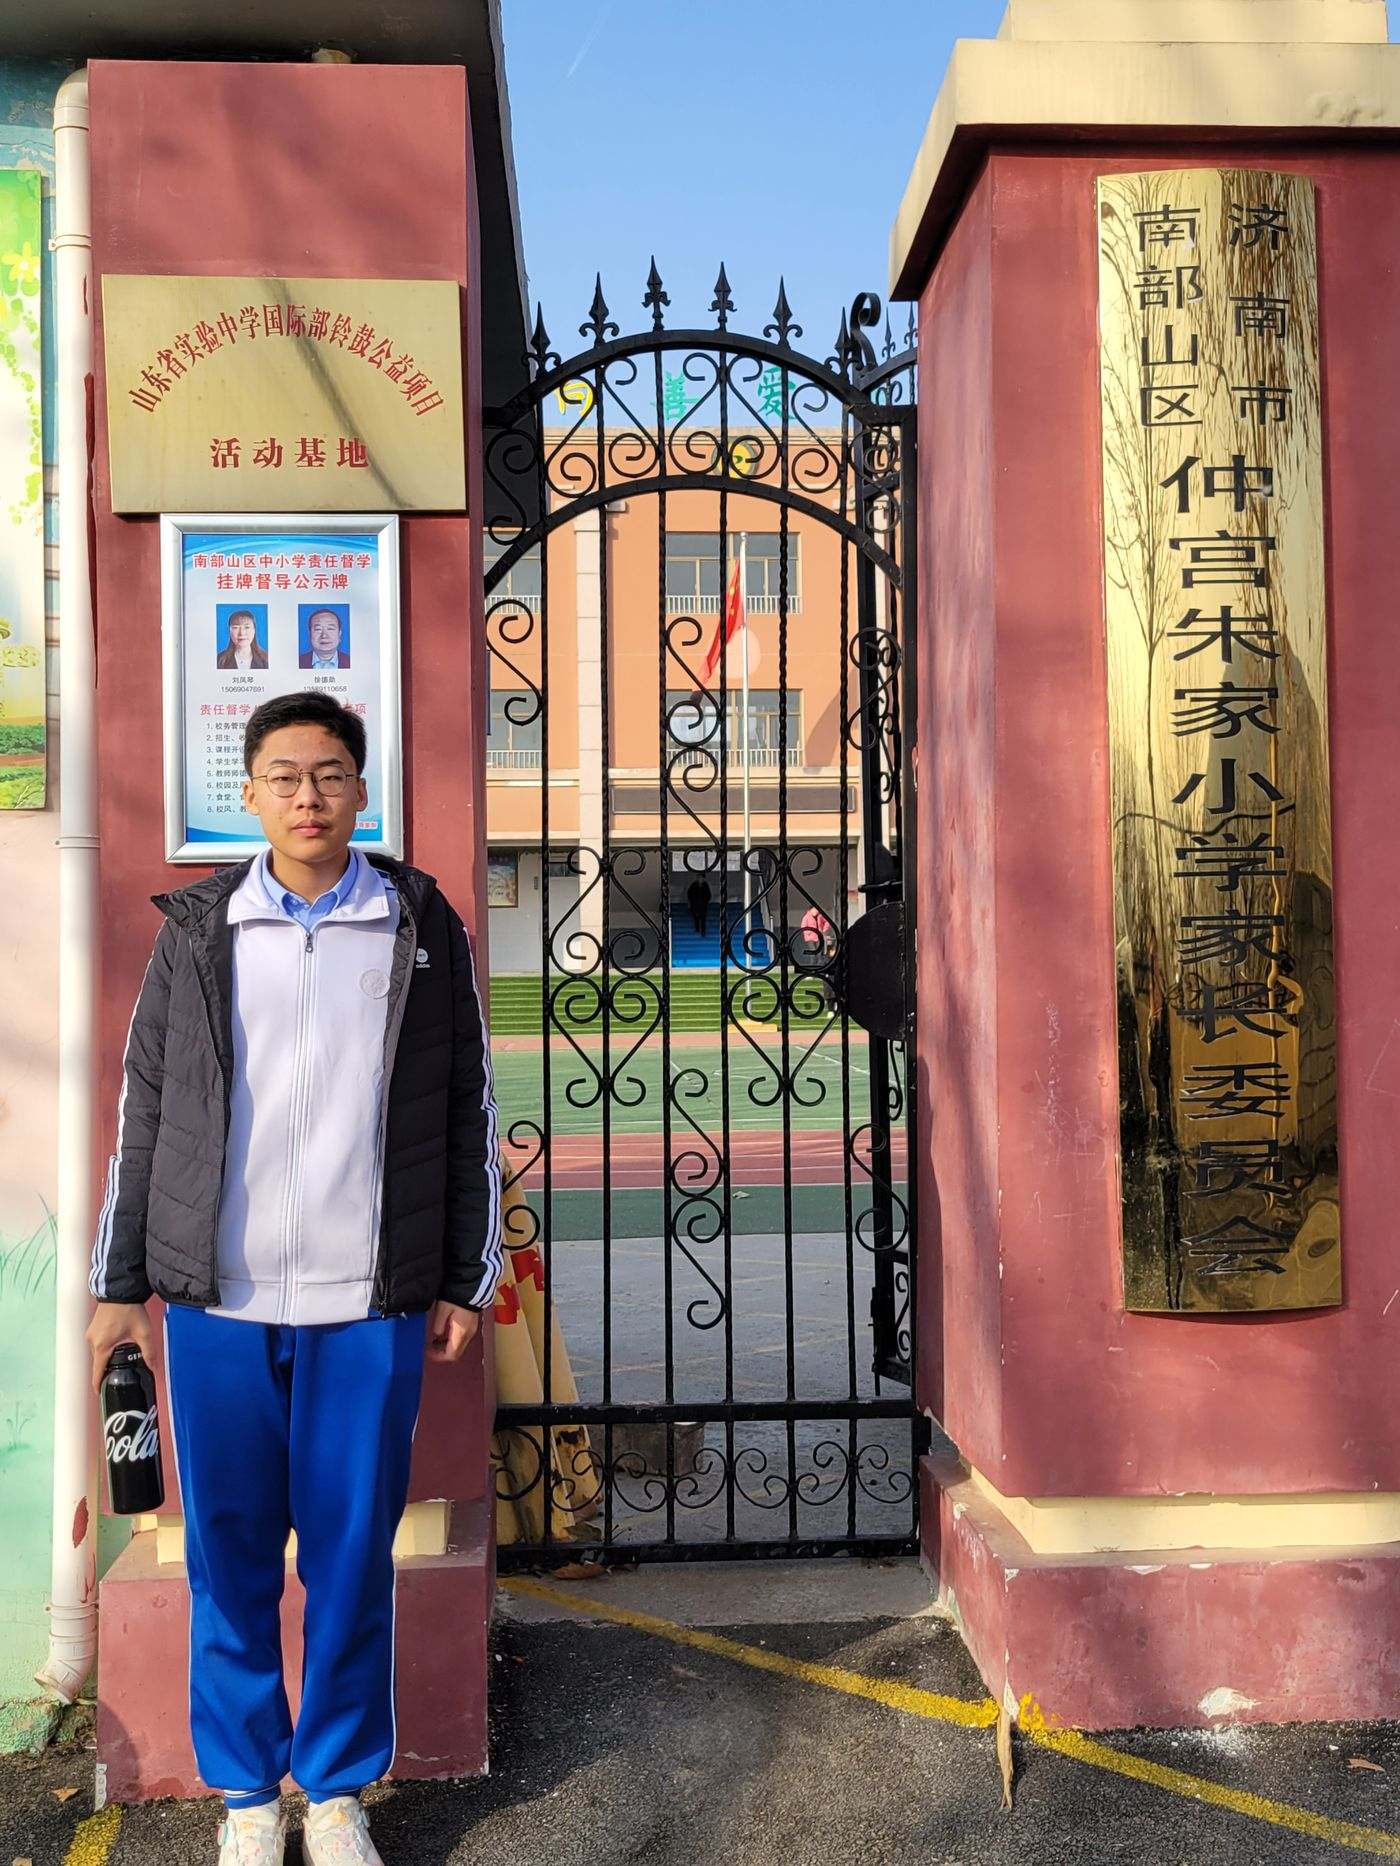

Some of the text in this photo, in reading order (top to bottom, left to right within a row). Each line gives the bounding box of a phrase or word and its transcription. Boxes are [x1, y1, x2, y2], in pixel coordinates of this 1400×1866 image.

[128, 304, 445, 417] 山东省实验中学国际部铃鼓公益项目
[1133, 204, 1203, 427] 南部山区
[1228, 203, 1292, 426] 济南市
[210, 437, 370, 468] 活动基地
[193, 554, 371, 568] 南部山区中小学责任督学
[217, 573, 349, 590] 挂牌督导公示牌
[1158, 454, 1291, 1277] 仲宫朱家小学家长委员会
